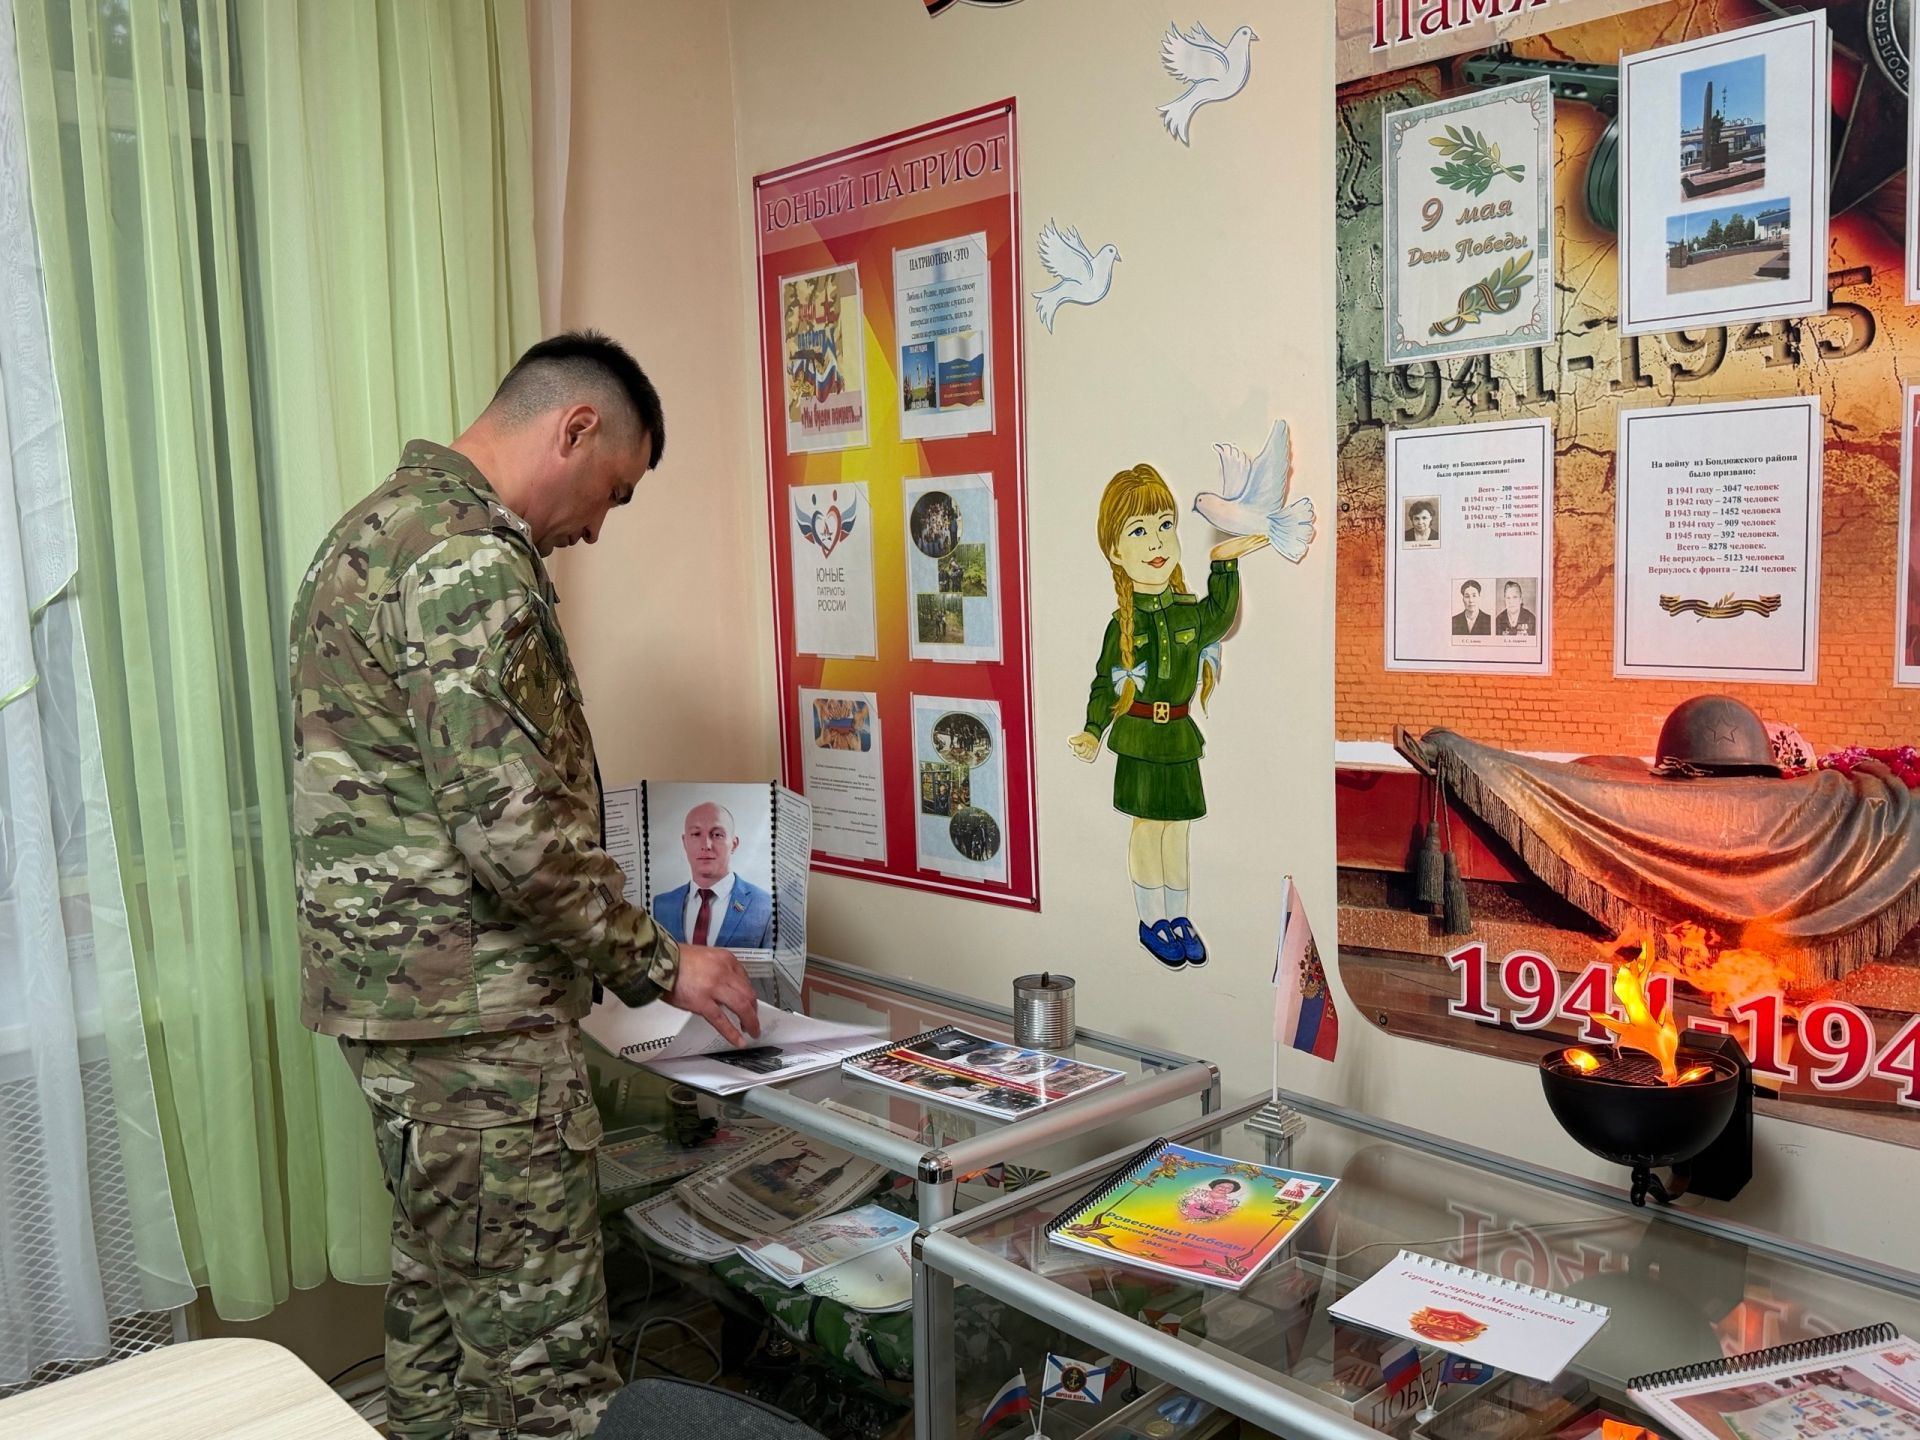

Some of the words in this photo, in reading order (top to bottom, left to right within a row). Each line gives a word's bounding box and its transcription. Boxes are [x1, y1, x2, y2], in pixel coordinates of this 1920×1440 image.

[766, 176, 855, 232] ЮНЫЙ
[861, 136, 1006, 207] ПАТРИОТ
[1421, 198, 1443, 231] 9
[1455, 199, 1513, 226] мая
[1407, 247, 1450, 266] День
[1455, 232, 1528, 263] Победы
[909, 251, 952, 271] ПАТРИОТИЗМ
[1665, 460, 1689, 469] войну
[1705, 456, 1763, 466] Бондюжского
[1765, 454, 1798, 463] района
[1689, 469, 1711, 478] было
[1713, 468, 1756, 478] призвано:
[1676, 486, 1693, 494] 1941
[1696, 486, 1714, 495] году
[1722, 485, 1742, 493] 3047
[1744, 483, 1779, 492] человек
[1667, 498, 1673, 506] В
[1696, 497, 1714, 506] году
[1722, 496, 1742, 504] 2478
[1744, 495, 1779, 503] человек
[1665, 510, 1671, 518] В
[1673, 509, 1691, 517] 1943
[1693, 509, 1710, 518] году
[1720, 508, 1739, 516] 1452
[1741, 507, 1781, 515] человека
[1669, 521, 1675, 529] В
[1698, 521, 1715, 529] году
[1724, 519, 1739, 527] 909
[1741, 519, 1776, 527] человек
[1666, 532, 1672, 540] В
[1694, 532, 1711, 541] году
[1721, 530, 1735, 538] 392
[1737, 530, 1779, 538] человека.
[1677, 543, 1699, 551] Всего
[1708, 542, 1728, 550] 8278
[1729, 542, 1766, 550] человек.
[1672, 555, 1715, 563] вернулось
[816, 567, 845, 583] ЮНЫЕ
[1648, 566, 1691, 574] Вернулось
[1699, 565, 1730, 575] фронта
[1740, 565, 1758, 573] 2241
[1761, 565, 1797, 573] человек
[816, 586, 846, 597] ПАТРИОТЫ
[817, 600, 847, 612] РОССИИ
[1105, 1211, 1183, 1237] Ровесница
[1185, 1233, 1246, 1251] Победы
[1400, 1270, 1444, 1288] Героям
[1445, 1284, 1486, 1300] города
[1487, 1295, 1576, 1326] Менделеевска
[1429, 1289, 1526, 1321] посвящается...
